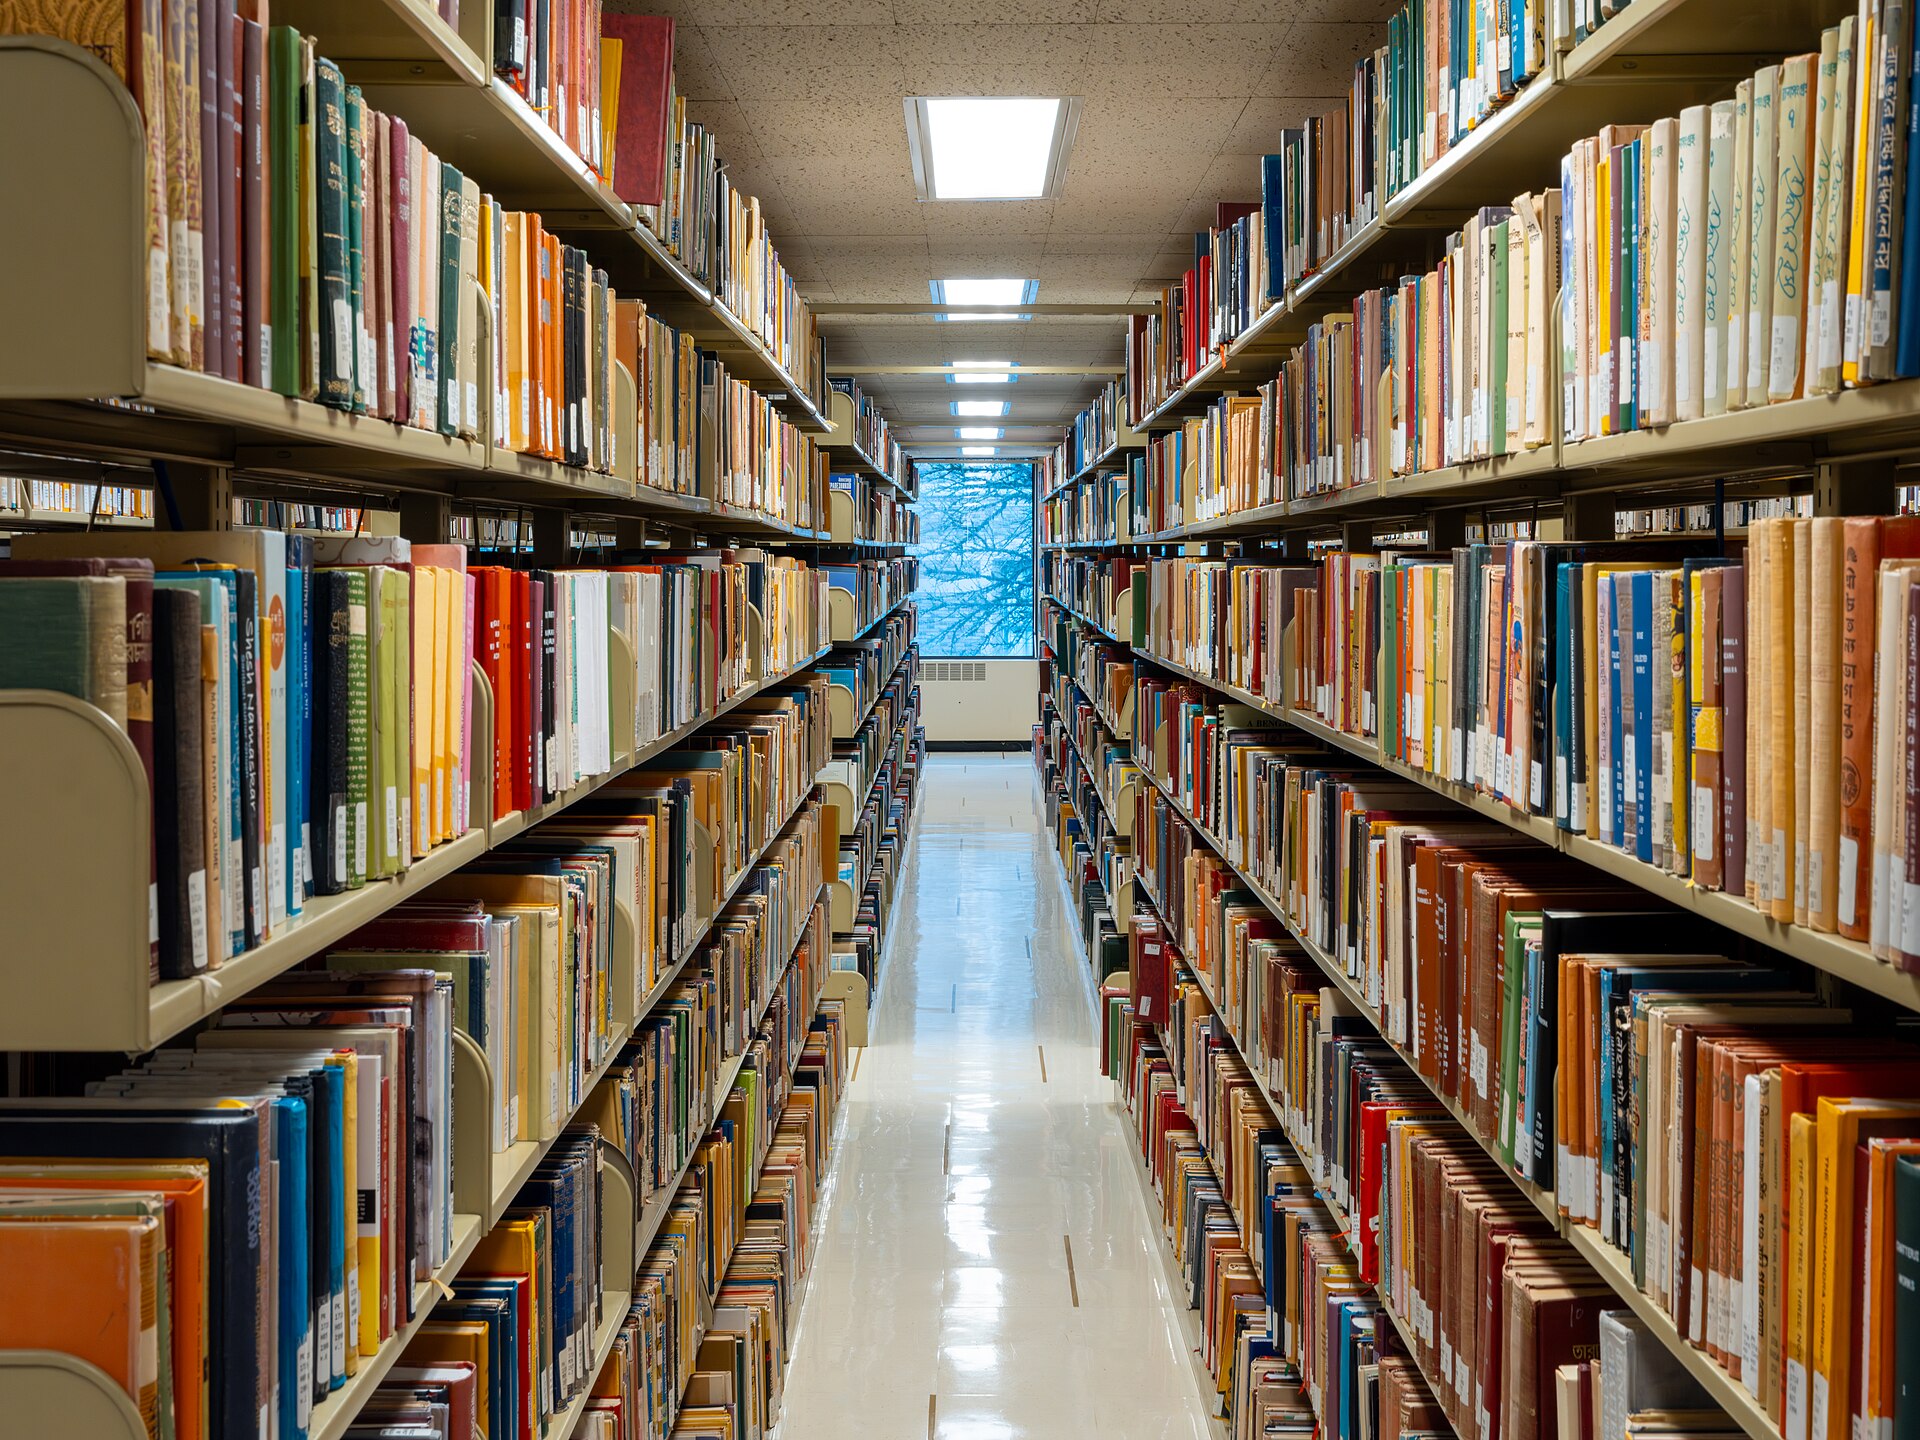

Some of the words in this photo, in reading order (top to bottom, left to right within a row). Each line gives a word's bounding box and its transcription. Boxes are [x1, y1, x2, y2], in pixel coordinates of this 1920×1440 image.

[245, 618, 255, 685] Shesh
[246, 693, 257, 812] Namaskar
[1247, 719, 1253, 728] A
